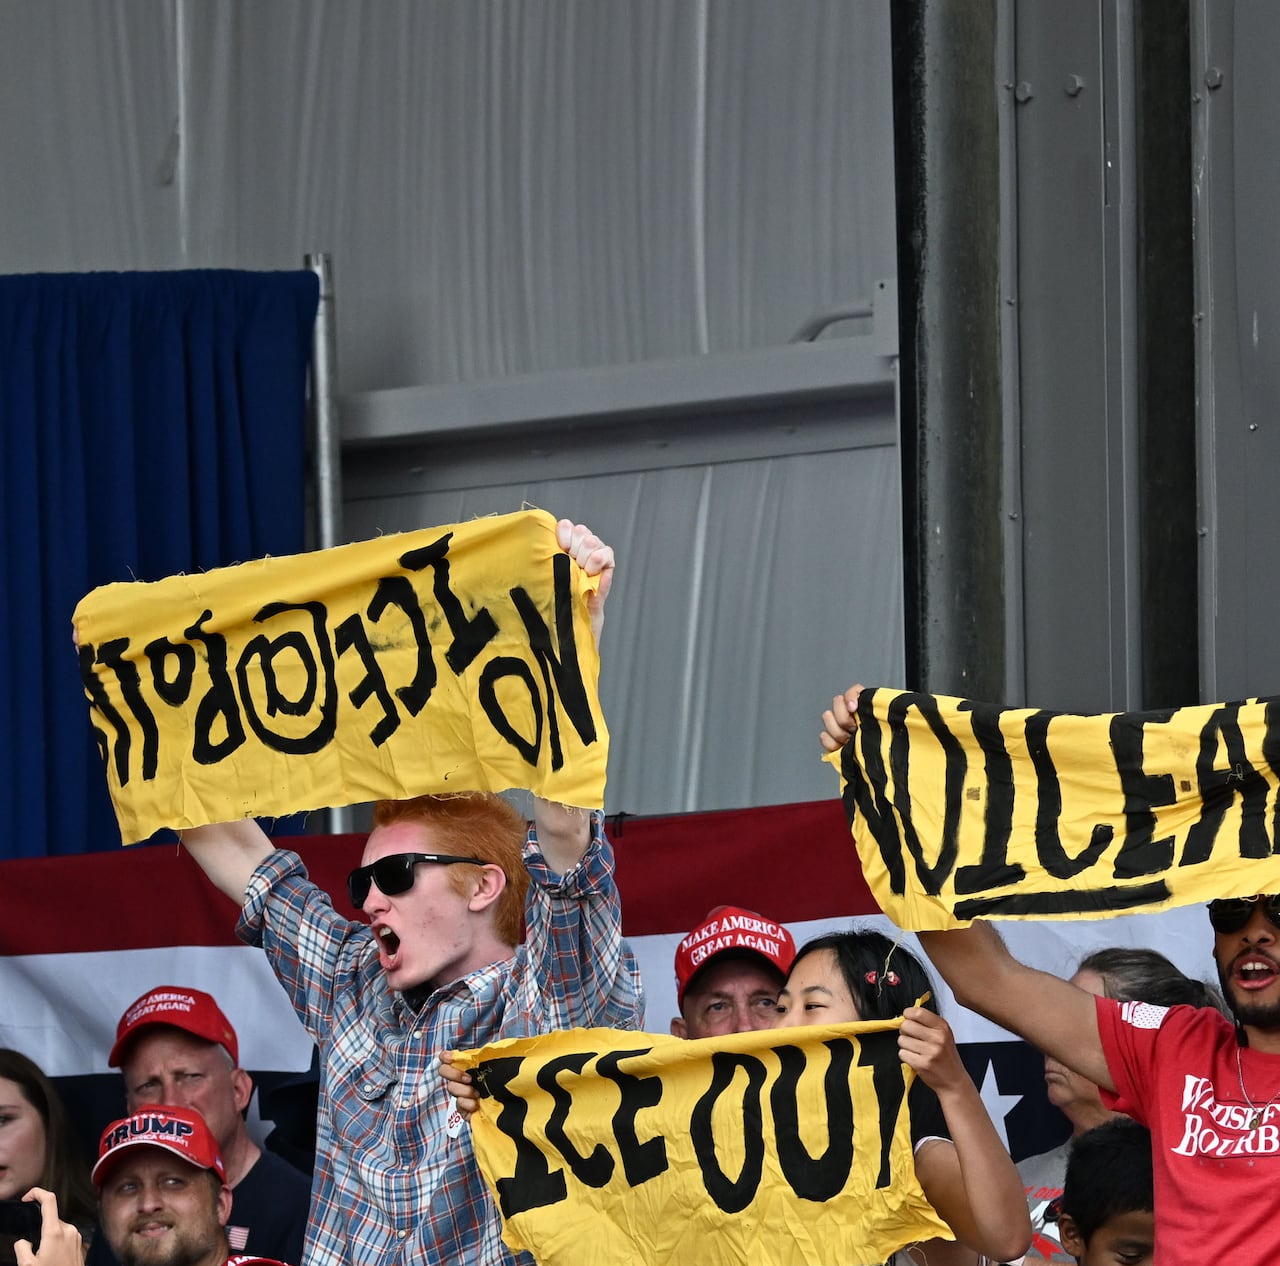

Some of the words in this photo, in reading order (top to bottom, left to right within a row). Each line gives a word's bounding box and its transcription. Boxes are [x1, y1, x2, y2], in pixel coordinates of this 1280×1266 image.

[478, 553, 596, 772] NO
[681, 920, 720, 953] MAKE
[720, 915, 786, 942] AMERICA
[690, 935, 733, 966] GREAT
[736, 933, 780, 958] AGAIN
[147, 993, 196, 1005] AMERICA
[156, 1001, 191, 1013] AGAIN
[105, 1117, 194, 1150] TRUMP
[470, 1046, 669, 1220] ICE
[689, 1029, 906, 1214] OUT
